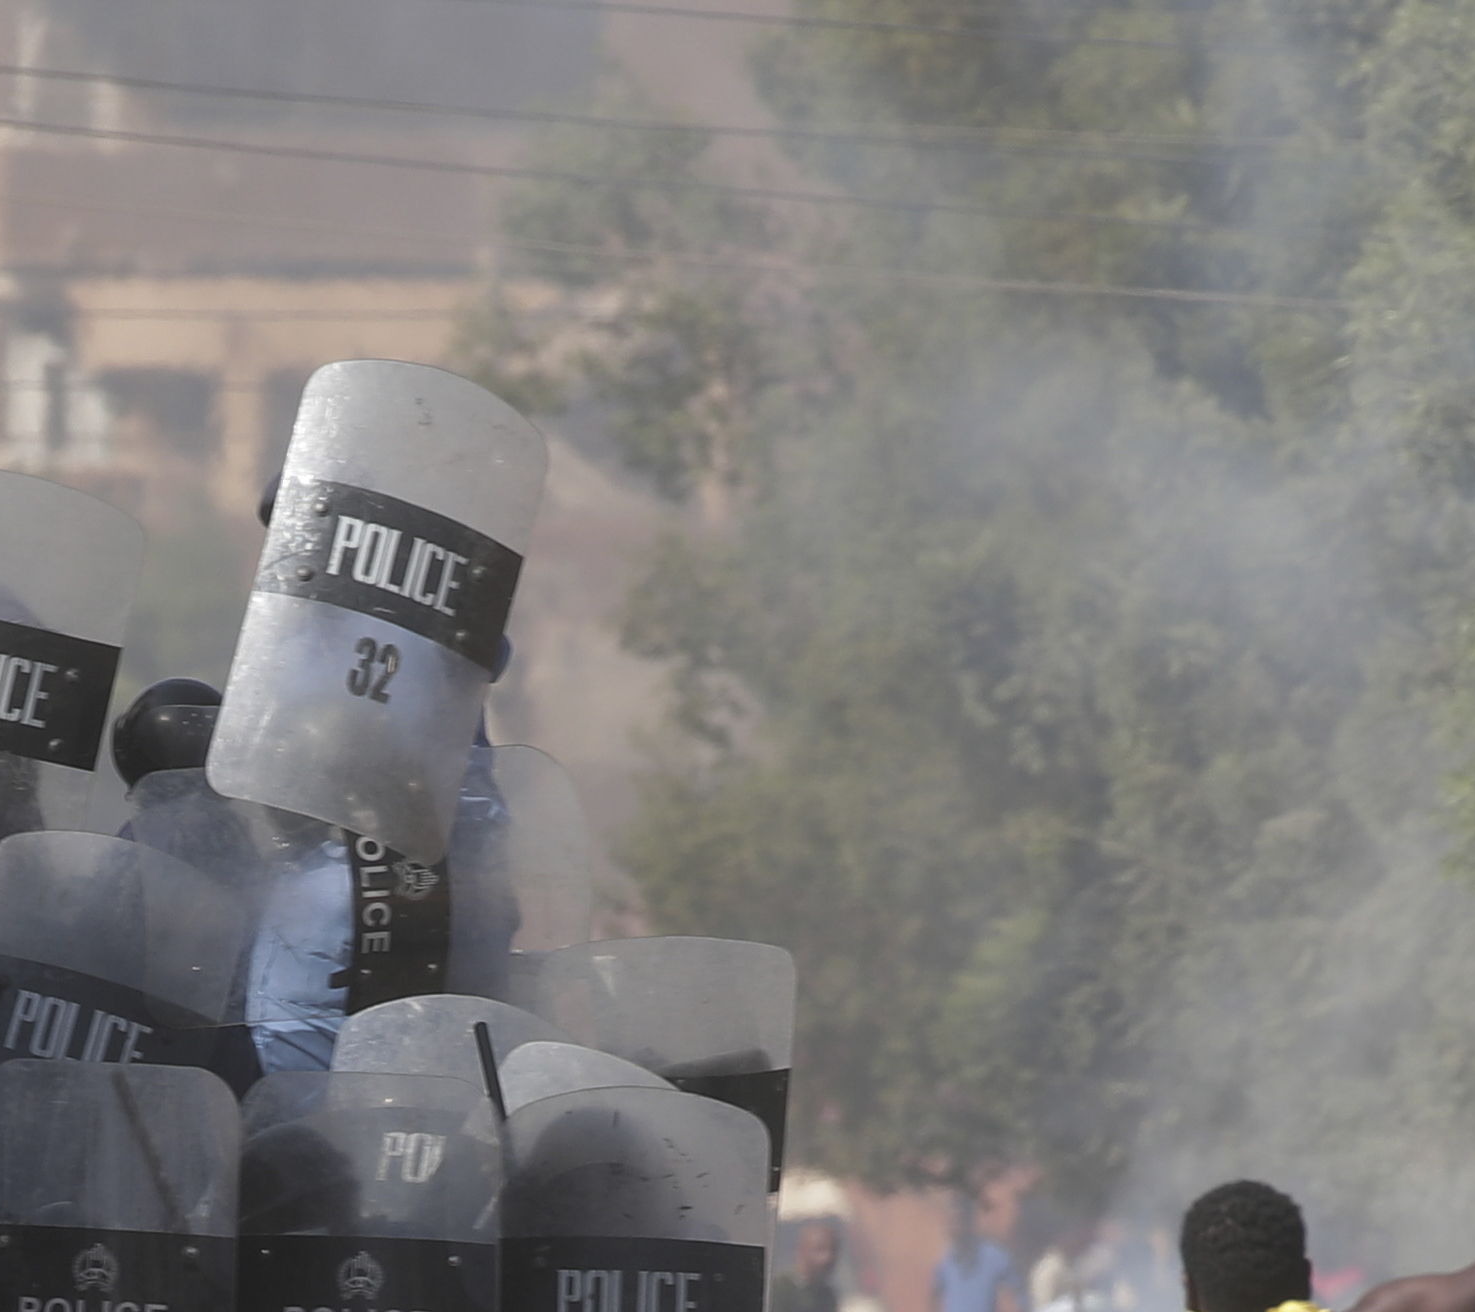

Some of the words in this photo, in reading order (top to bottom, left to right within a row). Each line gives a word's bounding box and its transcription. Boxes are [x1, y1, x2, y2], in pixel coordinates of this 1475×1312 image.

[326, 514, 469, 617] POLICE
[346, 636, 400, 704] 32
[355, 836, 392, 955] OLICE
[2, 988, 155, 1064] POLICE
